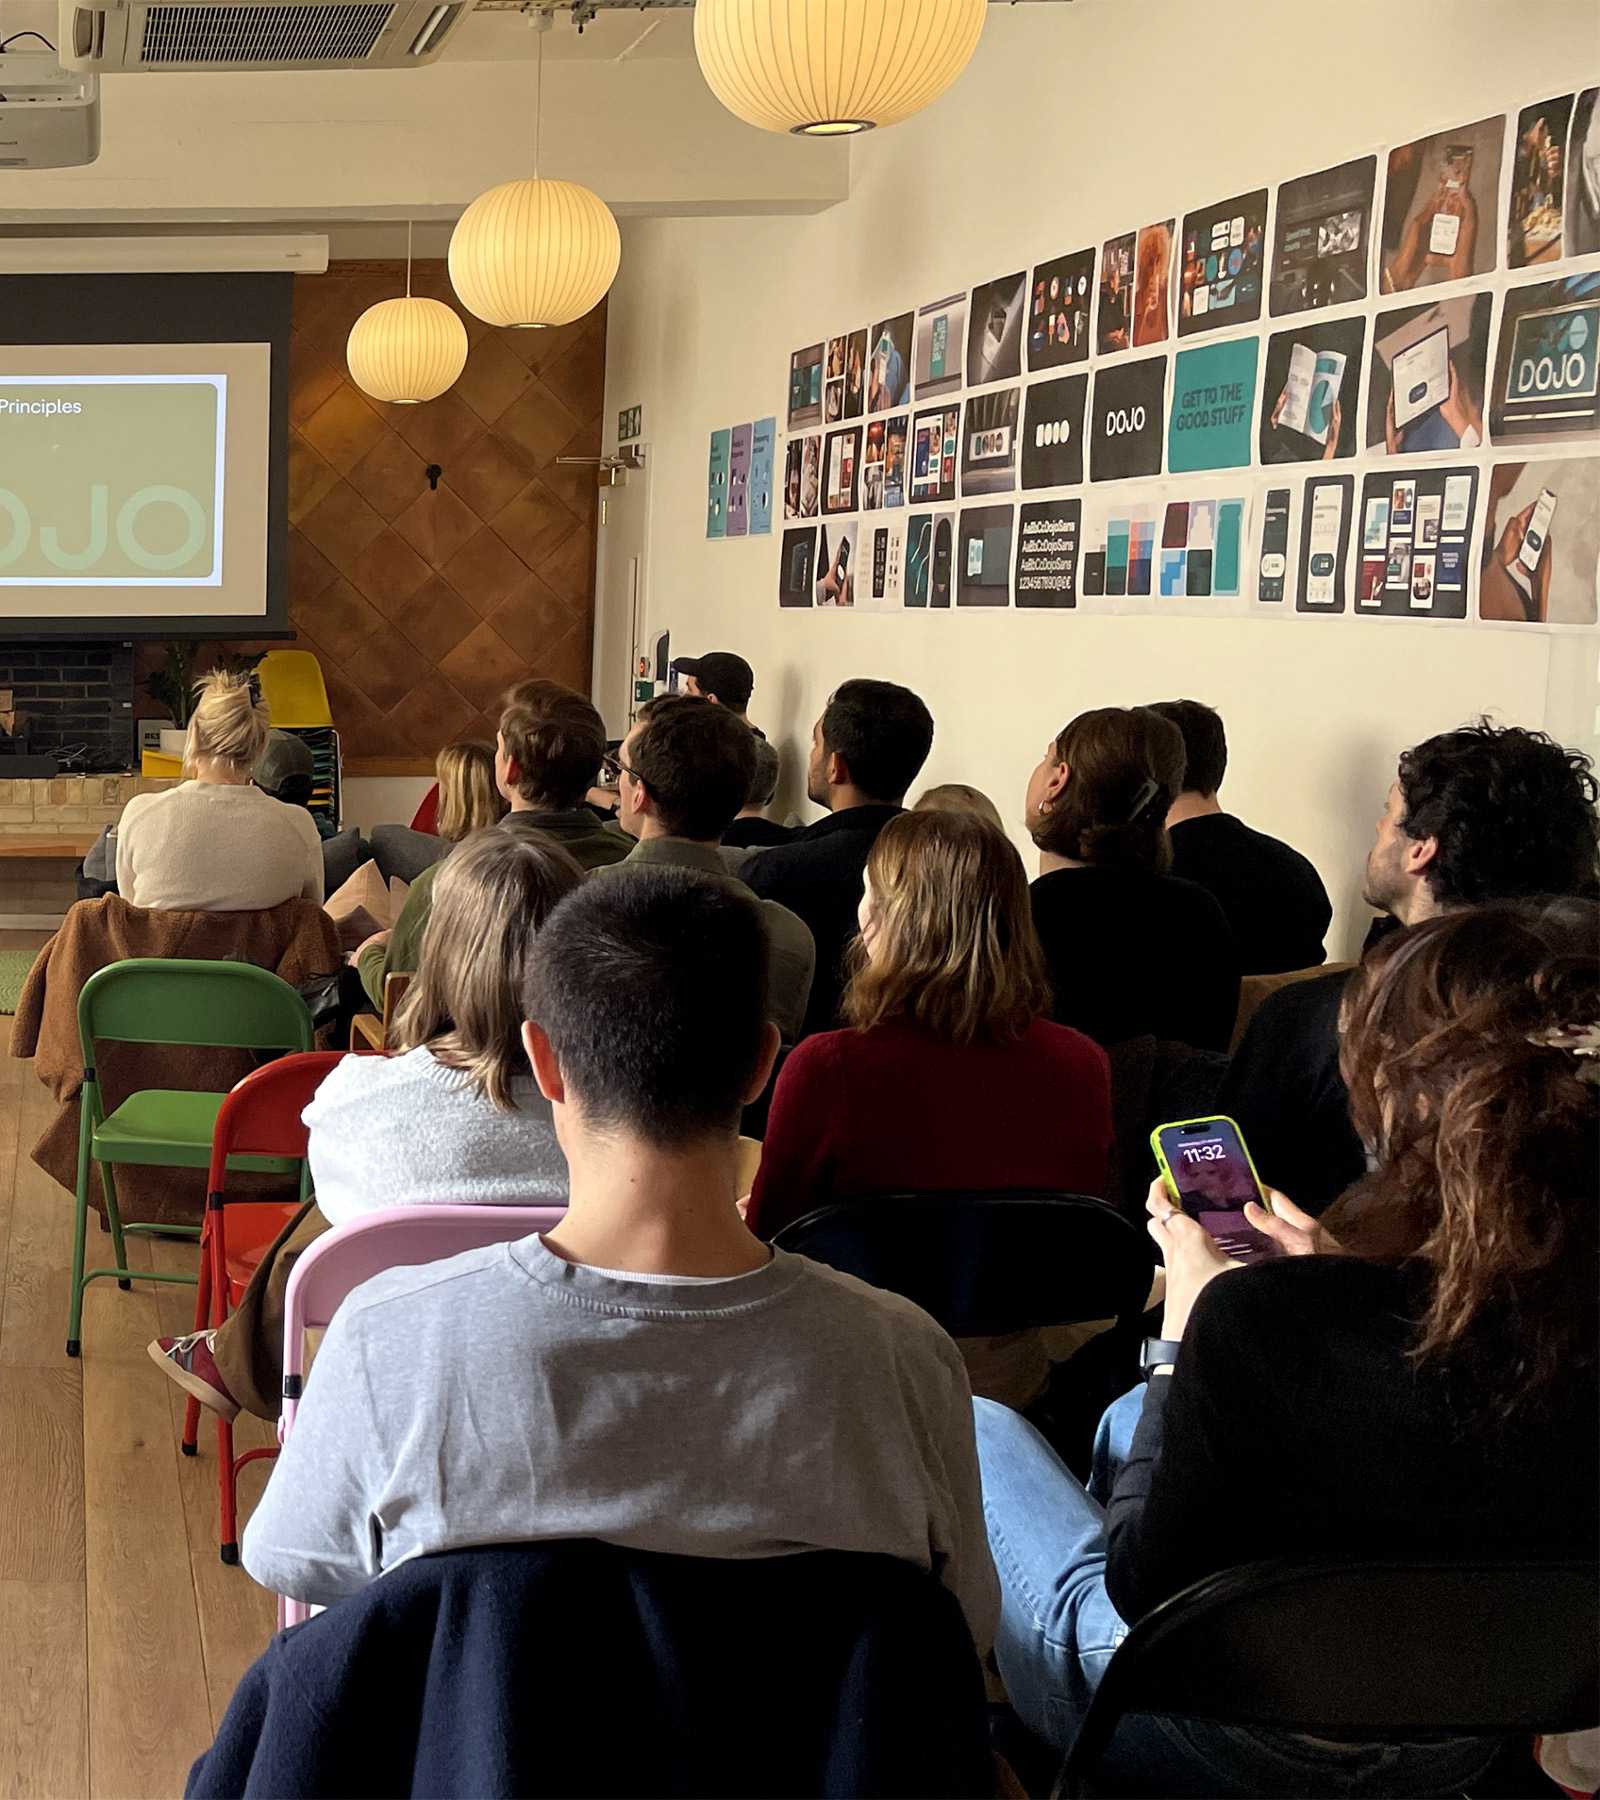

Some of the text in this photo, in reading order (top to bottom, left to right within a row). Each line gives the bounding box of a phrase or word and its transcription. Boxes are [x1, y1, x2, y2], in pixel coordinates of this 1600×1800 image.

[1518, 352, 1585, 393] DOJO
[1182, 383, 1243, 408] GET TO THE
[1106, 406, 1146, 437] DOJO
[1176, 404, 1247, 431] GOOD STUFF
[1183, 1144, 1226, 1163] 11:32
